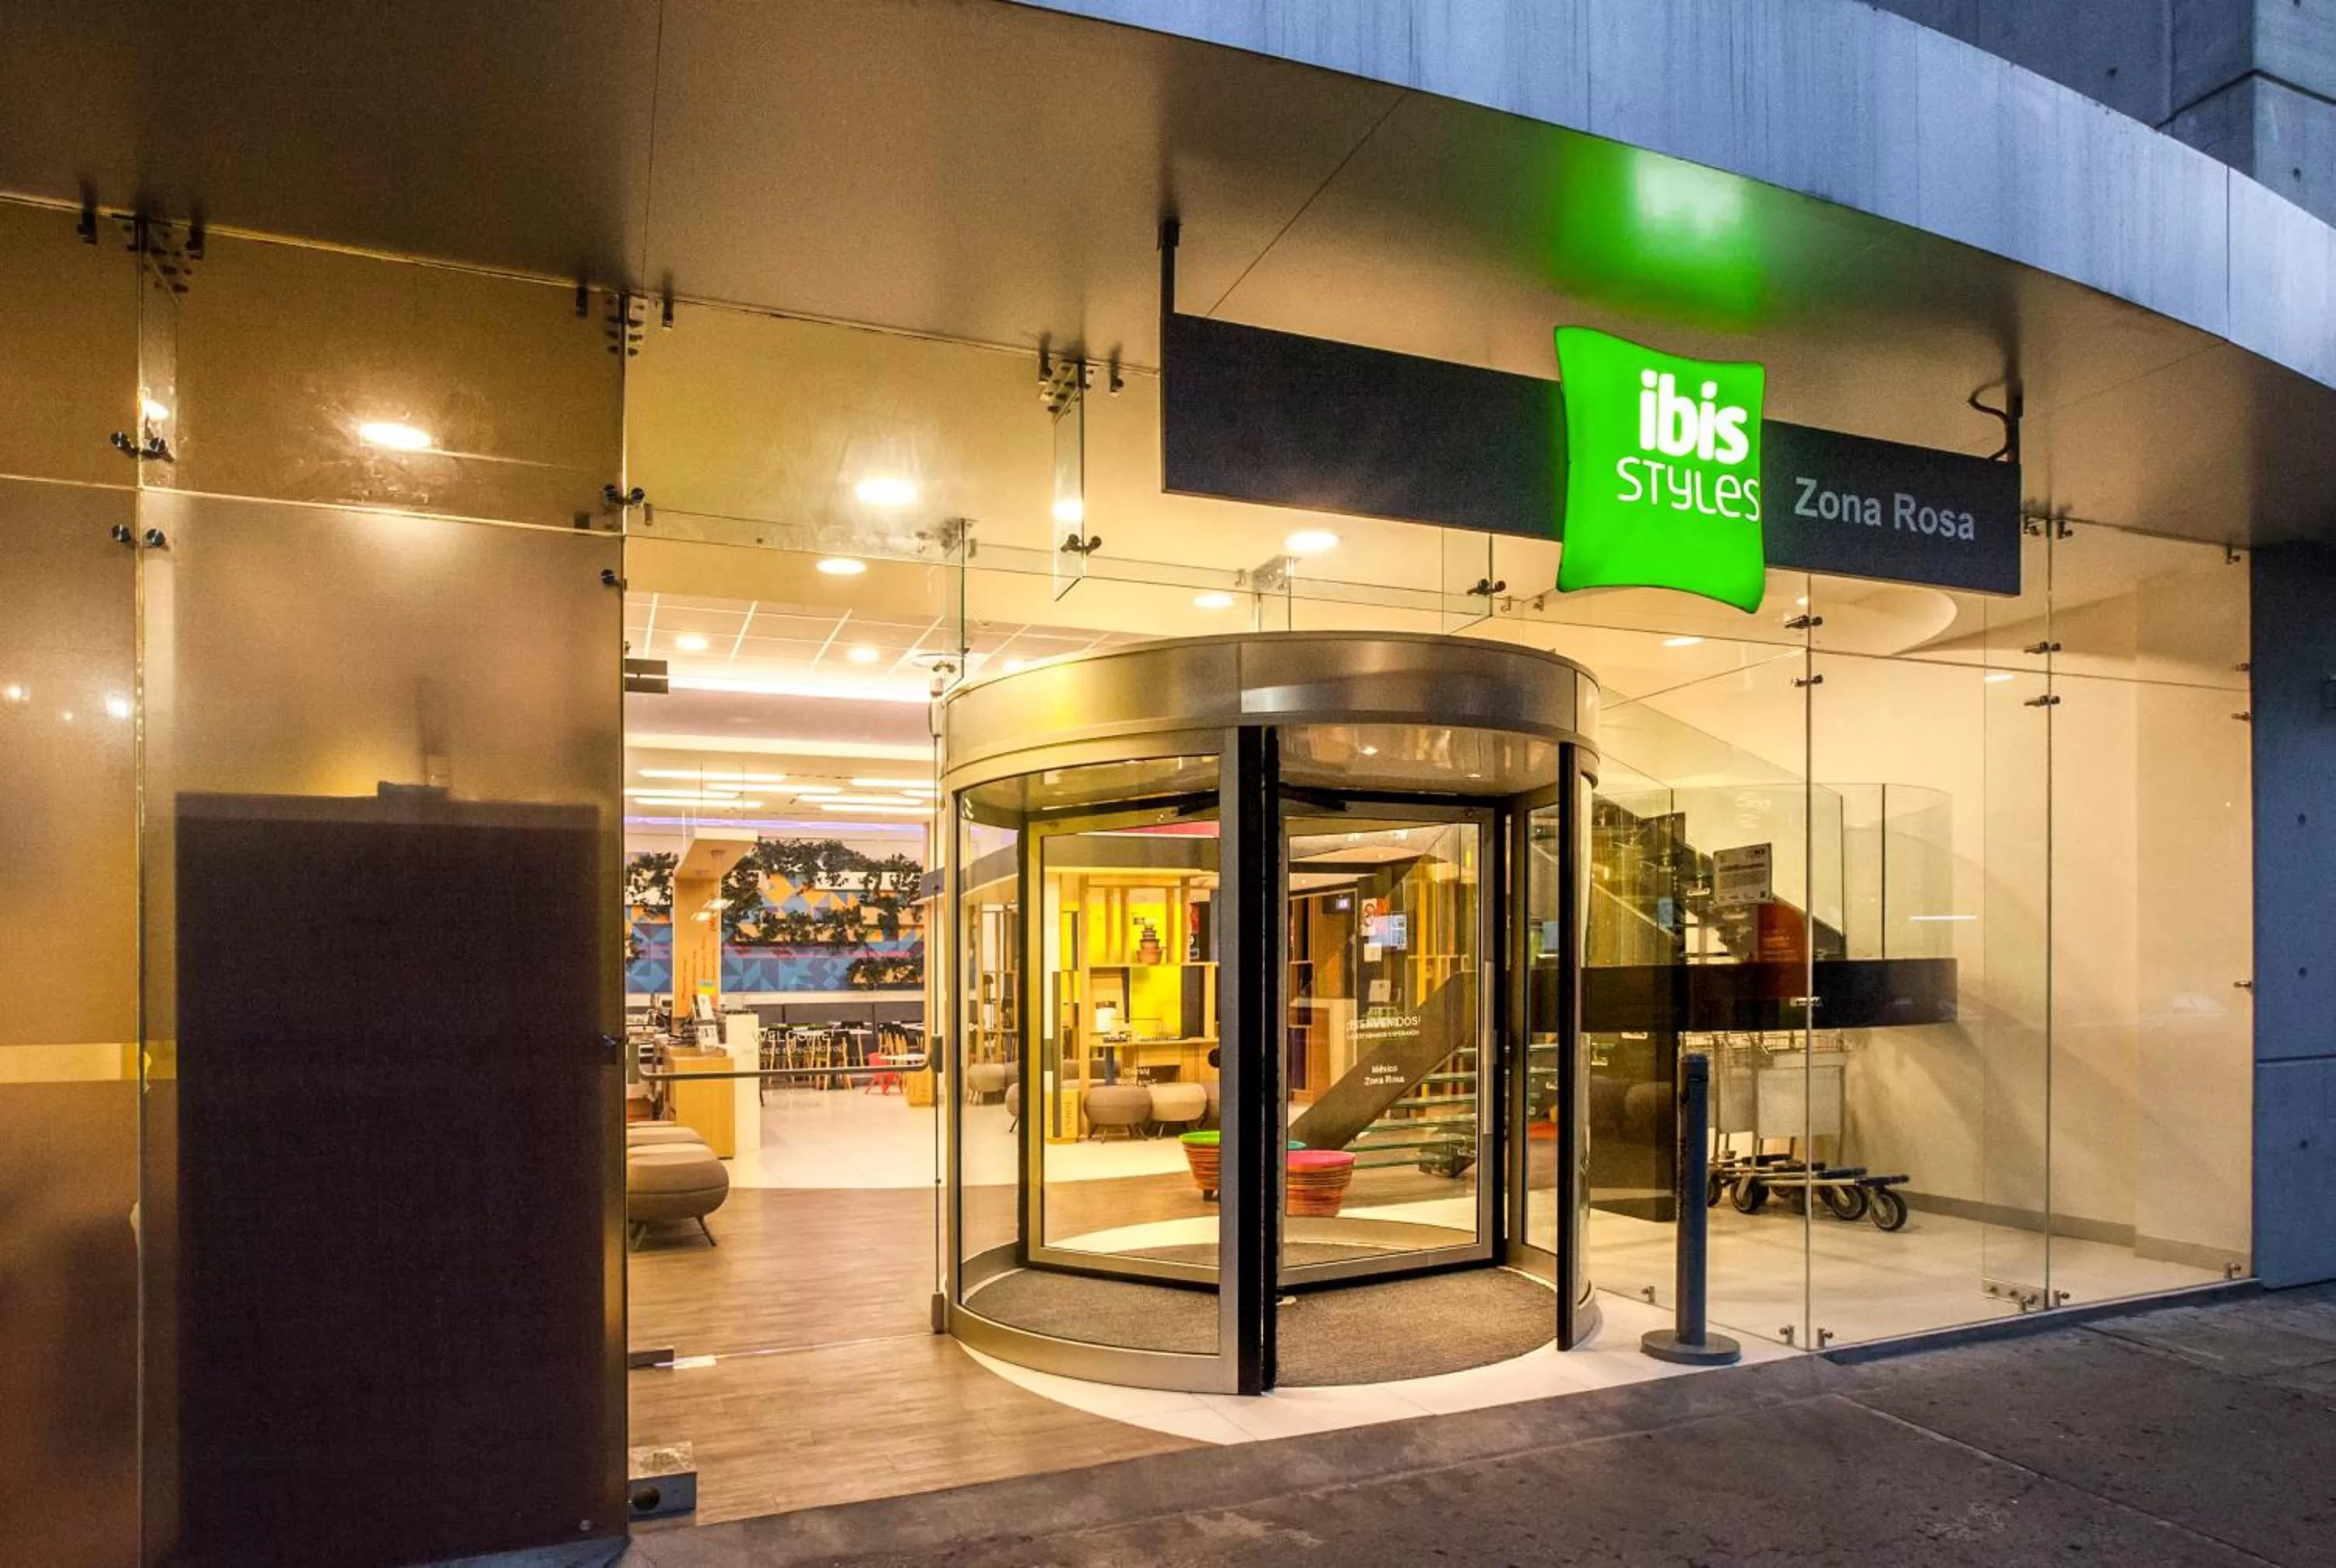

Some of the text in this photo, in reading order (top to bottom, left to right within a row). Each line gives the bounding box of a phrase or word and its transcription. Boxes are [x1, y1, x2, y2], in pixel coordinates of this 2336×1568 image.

[1639, 369, 1749, 465] ibis
[1795, 476, 1975, 541] Zona Rosa
